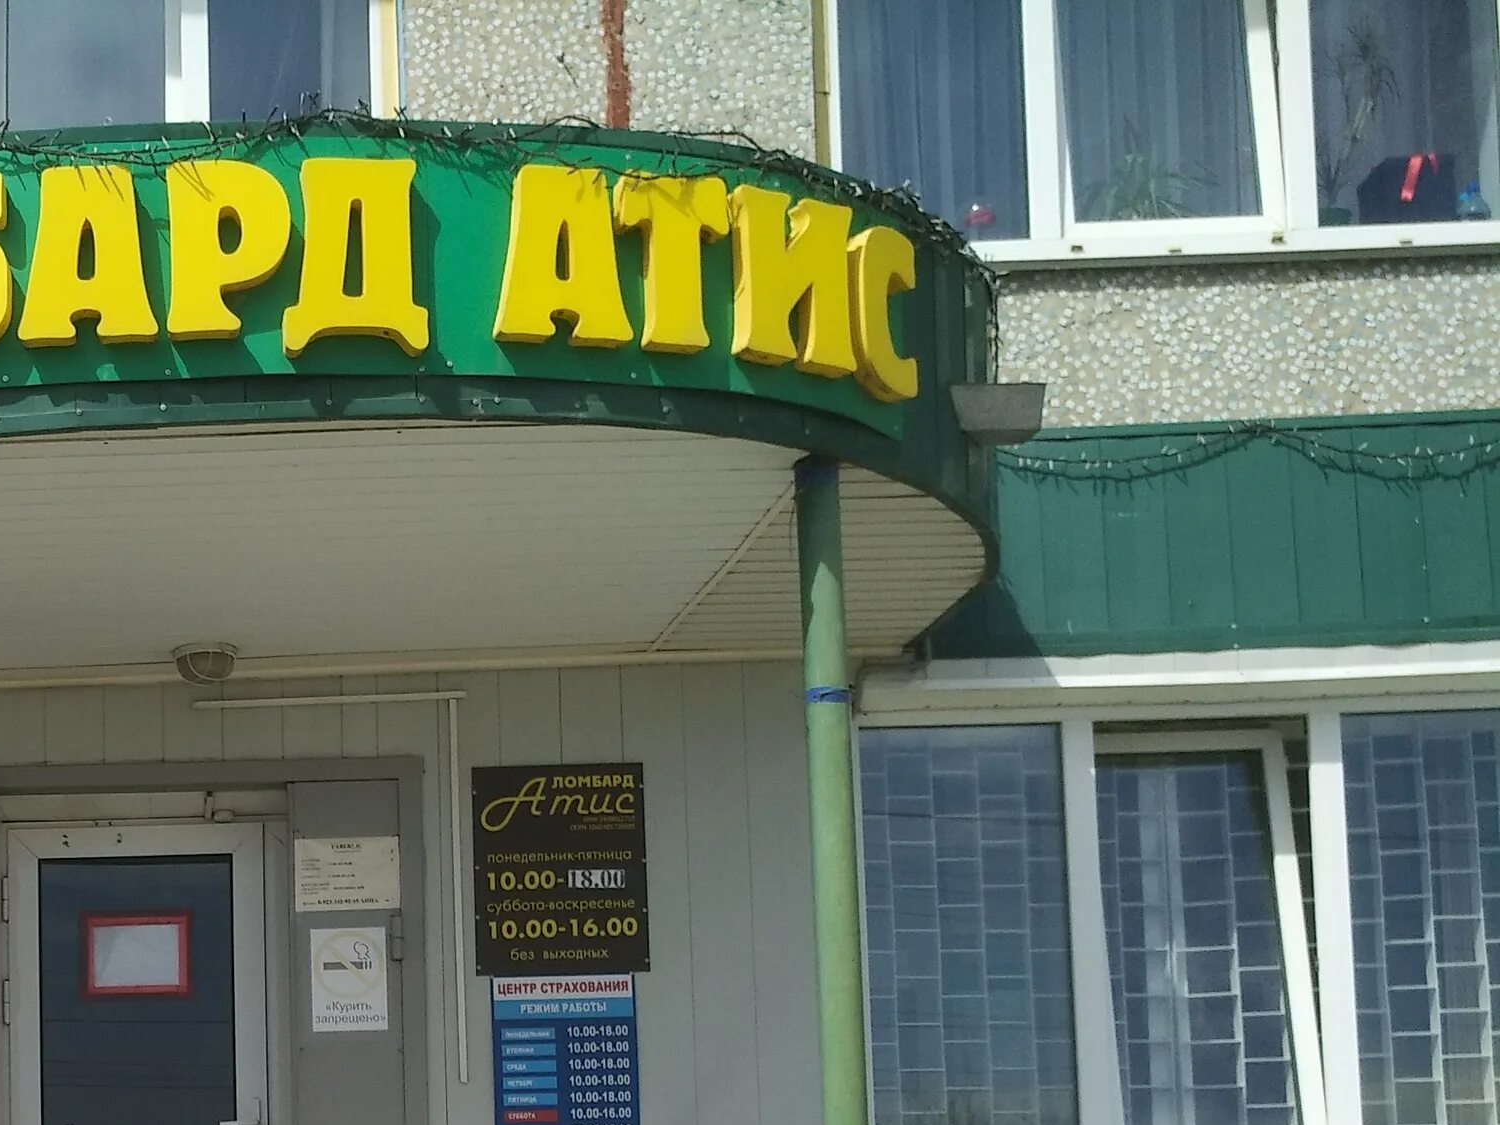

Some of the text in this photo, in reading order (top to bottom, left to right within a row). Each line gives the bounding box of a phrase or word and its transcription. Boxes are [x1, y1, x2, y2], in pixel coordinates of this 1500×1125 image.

[491, 163, 918, 402] АТИС
[551, 774, 635, 789] ЛОМБАРД
[480, 776, 636, 832] Атис
[487, 850, 632, 864] понедельник-пятница
[486, 898, 636, 915] суббота-воскресенье
[488, 917, 638, 940] 10.00-16.00
[510, 949, 609, 961] без выходных
[497, 980, 629, 997] ЦЕНТР СТРАХОВАНИЯ
[520, 1002, 607, 1014] РЕЖИМ РАБОТЫ
[567, 1025, 629, 1037] 10.00-18.00
[567, 1041, 629, 1053] 10.00-18.00
[568, 1058, 630, 1070] 10.00-18.00
[569, 1074, 631, 1087] 10.00-18.00
[569, 1091, 631, 1103] 10.00-18.00
[570, 1107, 632, 1120] 10.00-16.00
